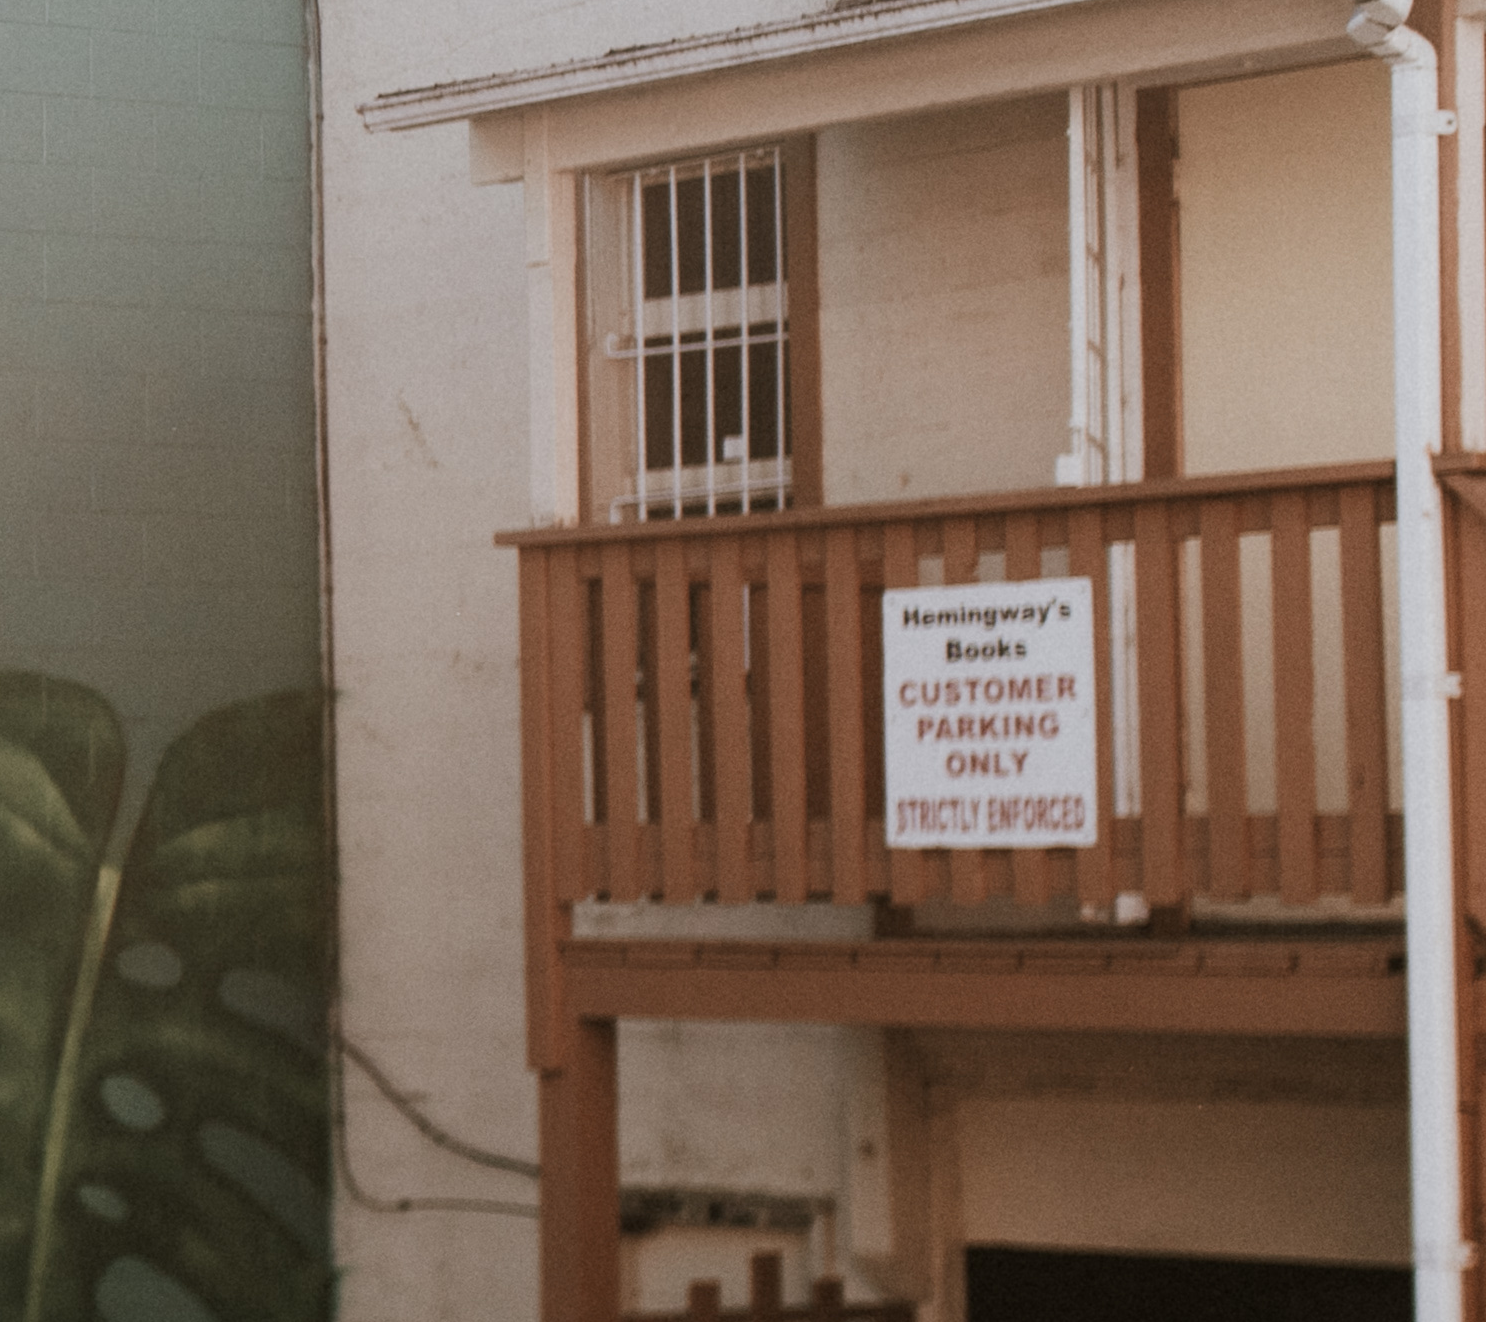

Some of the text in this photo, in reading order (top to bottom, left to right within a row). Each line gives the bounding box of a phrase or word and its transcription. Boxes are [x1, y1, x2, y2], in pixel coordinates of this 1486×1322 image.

[903, 598, 1071, 629] Hemingway's
[946, 639, 1027, 662] Books
[898, 675, 1077, 707] CUSTOMER
[917, 712, 1060, 742] PARKING
[945, 750, 1029, 778] ONLY
[897, 793, 1085, 835] STRICTLY ENFORCED
